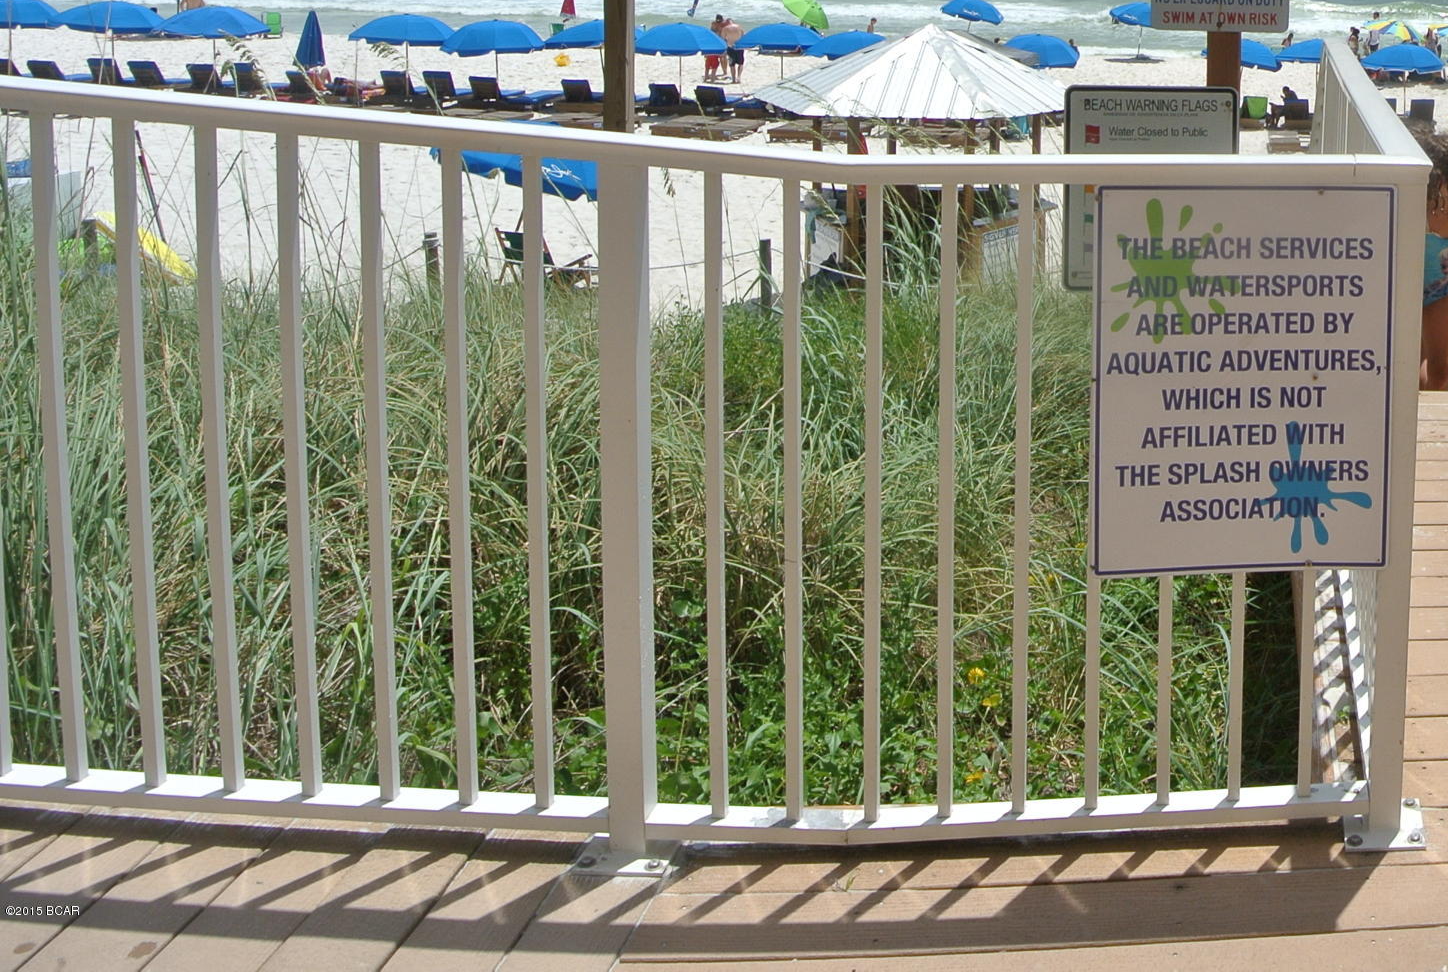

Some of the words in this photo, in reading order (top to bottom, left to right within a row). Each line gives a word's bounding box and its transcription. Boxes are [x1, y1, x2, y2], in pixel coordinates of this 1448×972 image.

[1162, 11, 1195, 24] SWIM
[1199, 12, 1214, 24] AT
[1217, 12, 1246, 26] OWN
[1249, 13, 1278, 25] RISK
[1084, 98, 1122, 111] BEACH
[1125, 99, 1178, 111] WARNING
[1181, 99, 1218, 112] FLAGS
[1108, 126, 1135, 136] Water
[1137, 127, 1168, 137] Closed
[1171, 128, 1179, 136] to
[1182, 127, 1208, 137] Public
[1119, 237, 1163, 260] THE
[1172, 237, 1251, 260] BEACH
[1259, 237, 1373, 260] SERVICES
[1127, 276, 1178, 299] AND
[1187, 275, 1363, 298] WATERSPORTS
[1136, 313, 1184, 336] ARE
[1191, 312, 1315, 335] OPERATED
[1323, 312, 1354, 333] BY
[1106, 350, 1212, 376] AQUATIC
[1219, 349, 1381, 375] ADVENTURES,
[1162, 387, 1240, 410] WHICH
[1250, 387, 1271, 408] IS
[1279, 386, 1326, 408] NOT
[1141, 424, 1277, 449] AFFILIATED
[1285, 423, 1344, 445] WITH
[1115, 464, 1160, 487] THE
[1168, 461, 1260, 485] SPLASH
[1269, 460, 1369, 482] OWNERS
[1160, 498, 1325, 523] ASSOCIATION.
